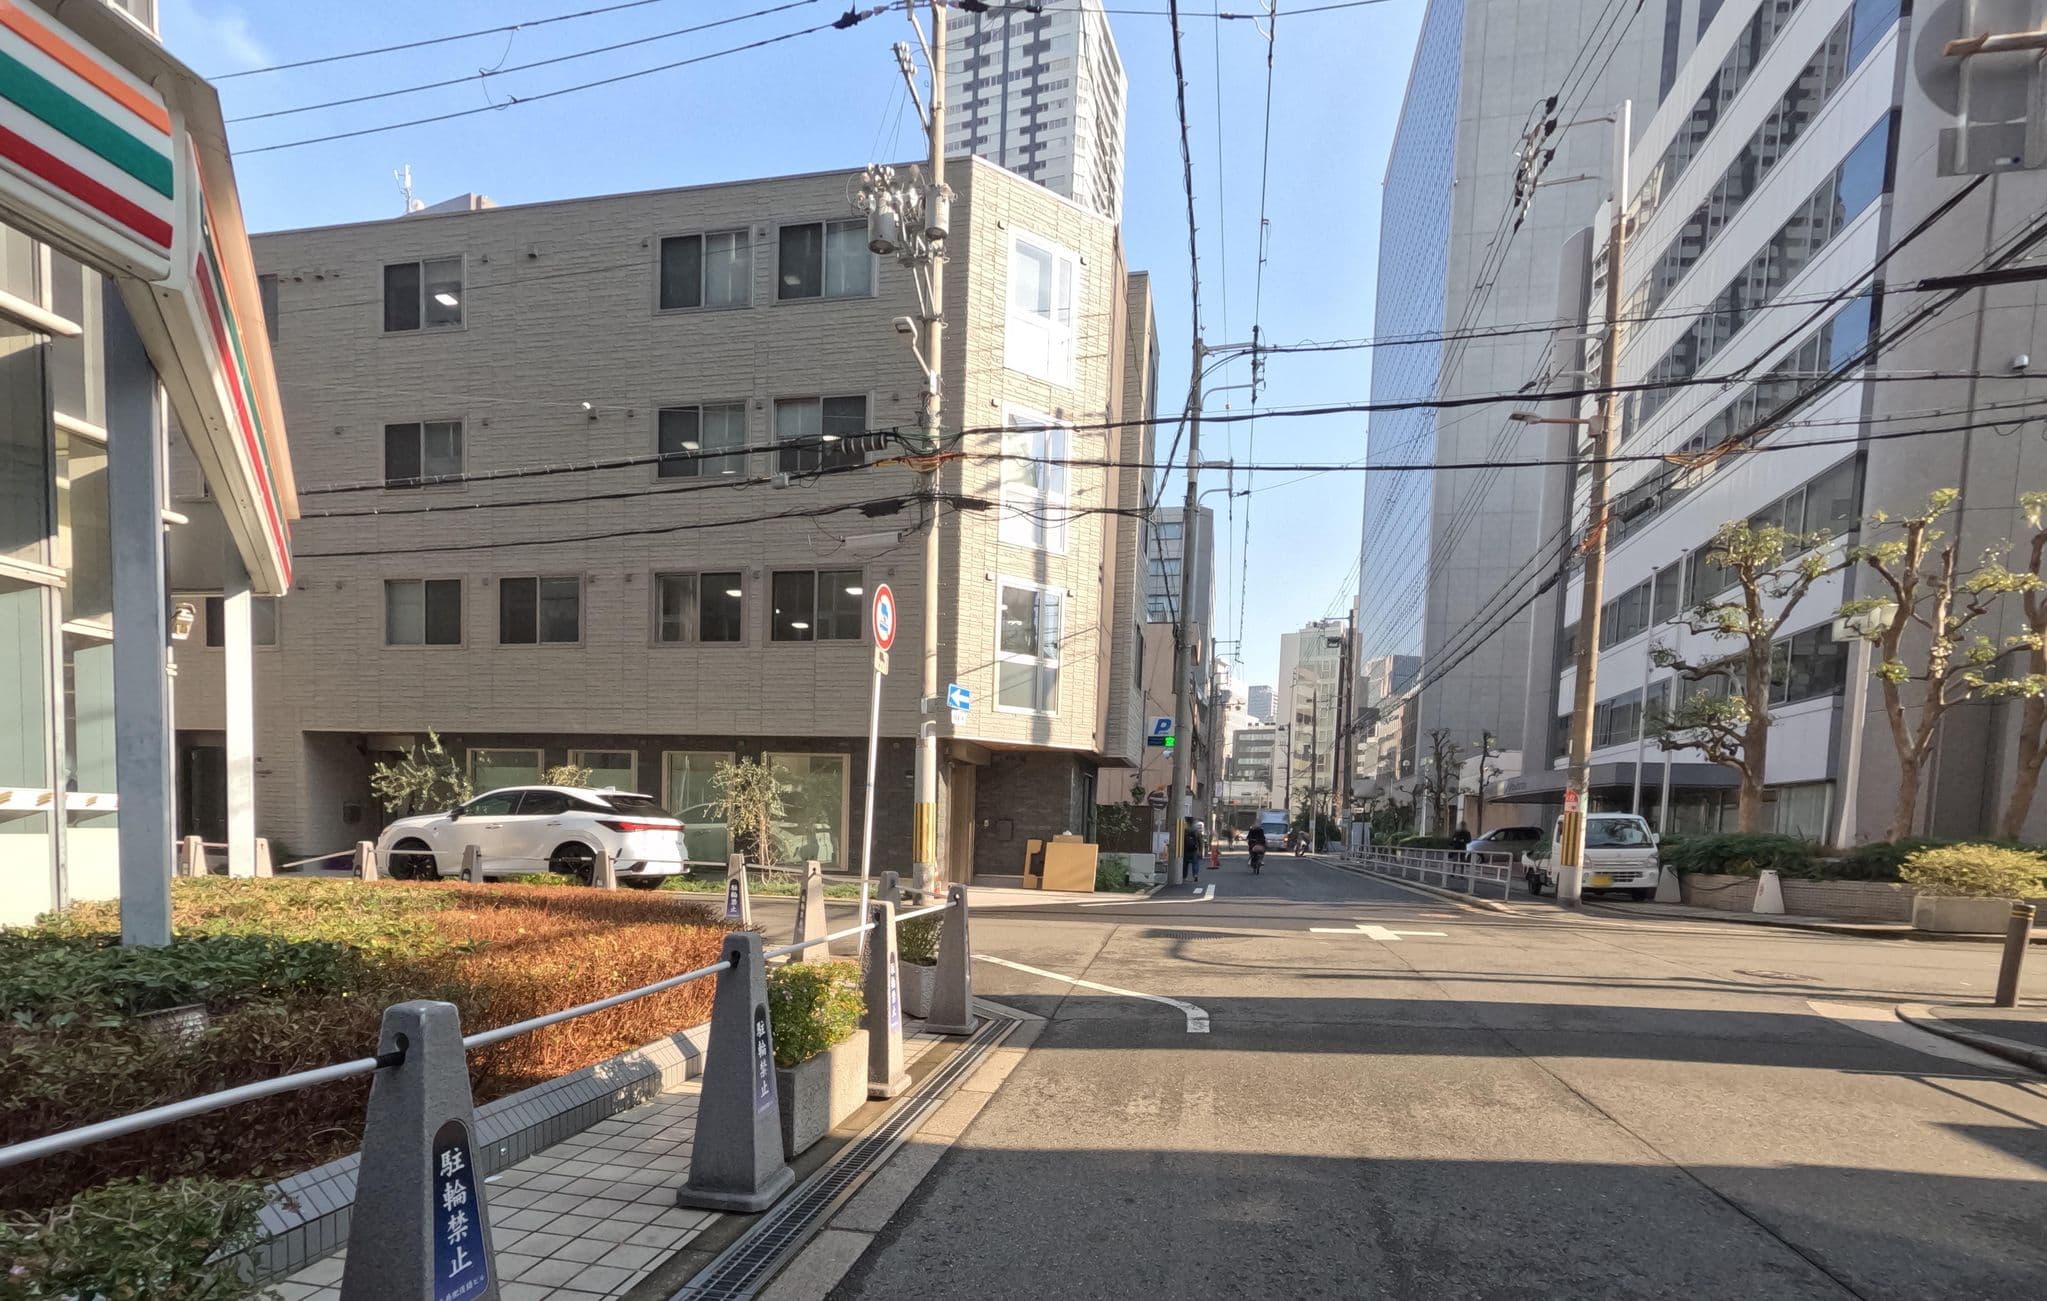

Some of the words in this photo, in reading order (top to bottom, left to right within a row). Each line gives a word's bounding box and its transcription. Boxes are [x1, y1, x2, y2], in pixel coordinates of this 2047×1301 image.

[1154, 718, 1172, 735] P
[756, 1020, 770, 1098] 駐輪禁止
[439, 1147, 473, 1278] 駐輪禁止
